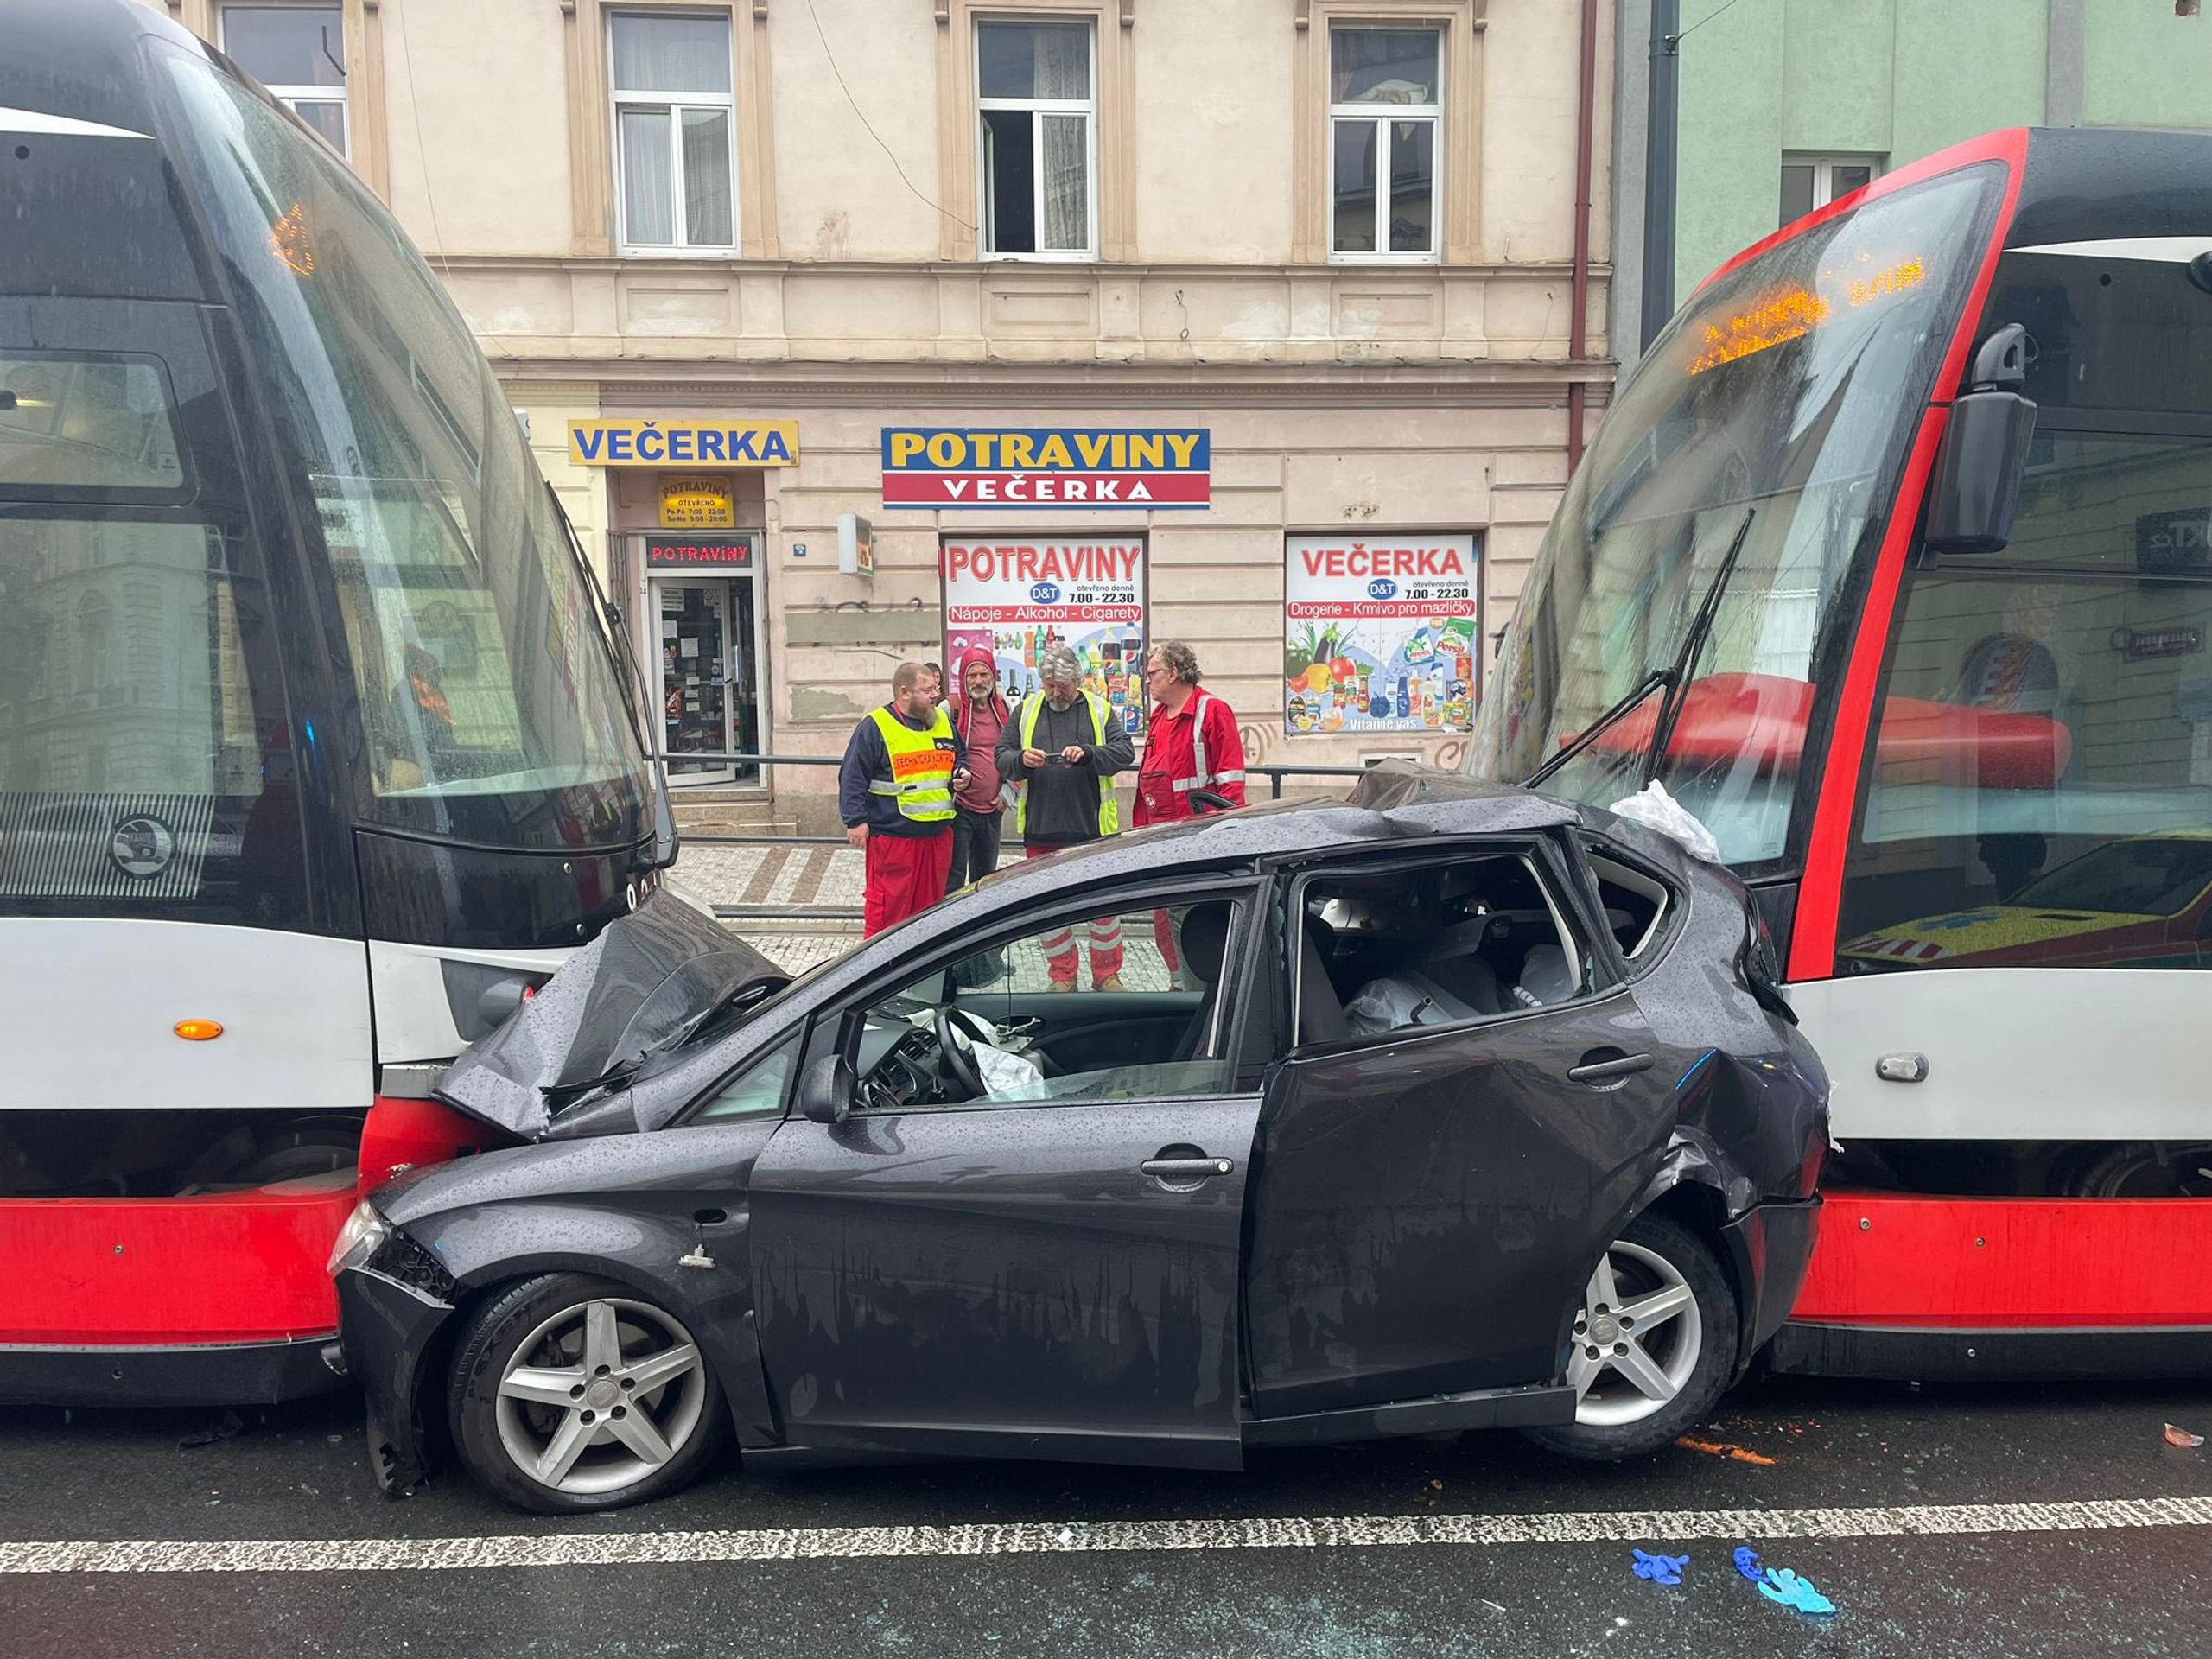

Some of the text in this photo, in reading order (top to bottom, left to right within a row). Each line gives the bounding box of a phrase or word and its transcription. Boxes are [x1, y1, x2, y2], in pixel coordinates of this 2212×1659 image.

[573, 421, 790, 461] VEČERKA
[890, 432, 1201, 468] POTRAVINY
[663, 481, 728, 499] POTRAVINY
[942, 474, 1154, 501] VEČERKA
[948, 545, 1141, 582] POTRAVINY
[1301, 543, 1464, 576] VEČERKA
[1033, 588, 1058, 599] D&T
[1370, 584, 1394, 594] D&T
[1405, 589, 1428, 600] 7.00
[1437, 588, 1468, 599] 22.30
[1069, 593, 1093, 603] 7.00
[1102, 593, 1135, 603] 22.30
[951, 607, 1002, 622] Nápoje
[1015, 607, 1068, 620] Alkohol
[1081, 606, 1141, 622] Cigarety
[1291, 603, 1342, 618] Drogerie
[1353, 602, 1395, 615] Krmivo
[1398, 604, 1417, 618] pro
[1421, 601, 1472, 614] mazlíčky
